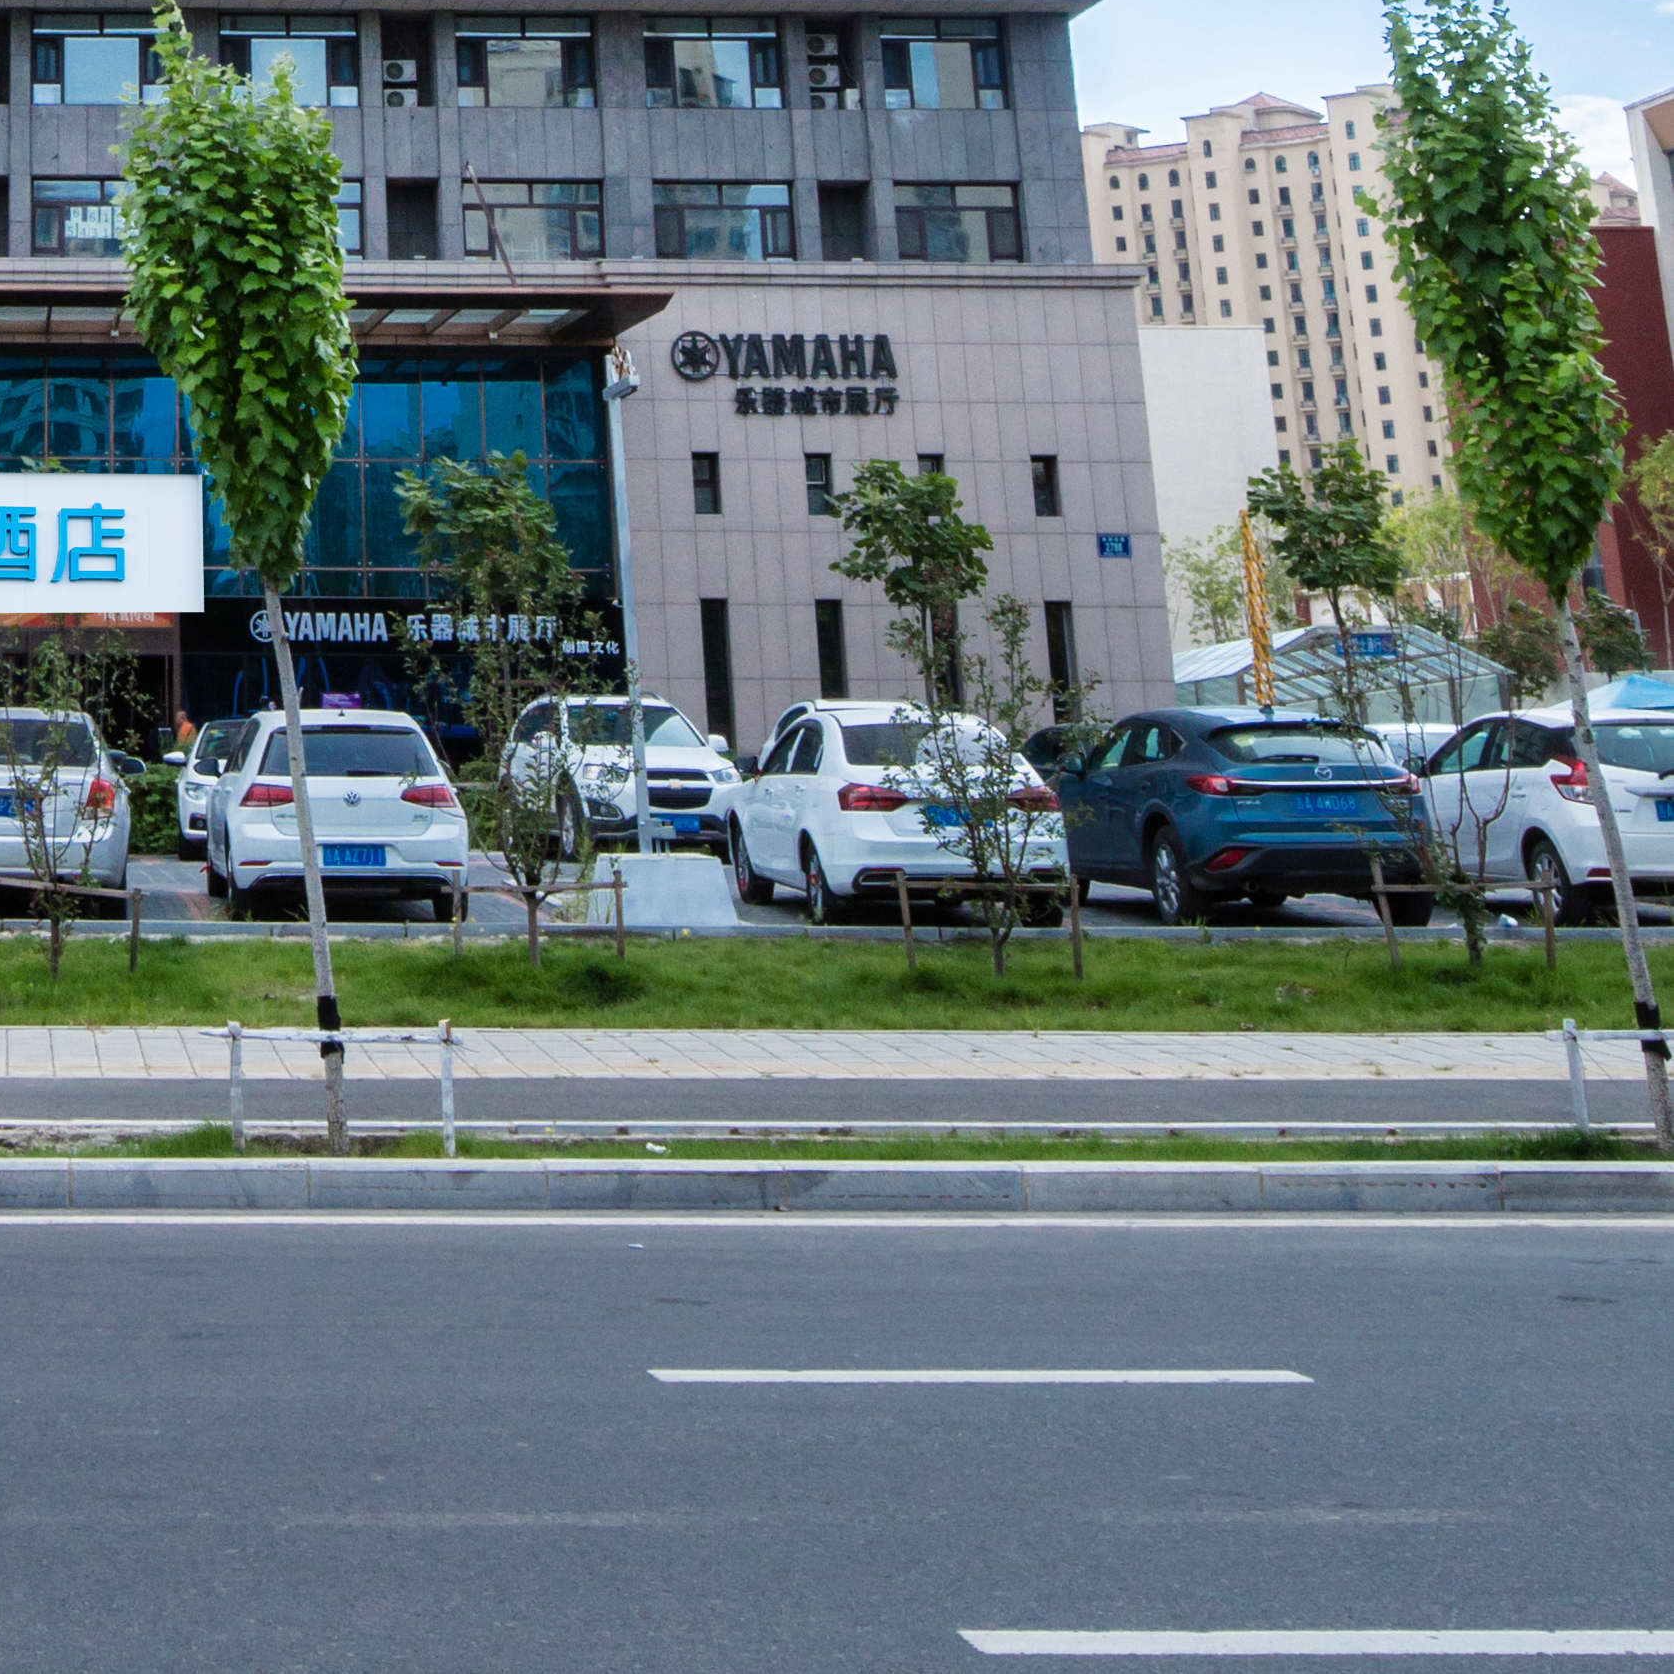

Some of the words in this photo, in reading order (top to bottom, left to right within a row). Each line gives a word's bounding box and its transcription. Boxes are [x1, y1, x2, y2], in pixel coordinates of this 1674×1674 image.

[719, 334, 898, 379] YAMAHA
[735, 386, 899, 416] 乐器城市展厅
[284, 612, 388, 642] YAMAHA
